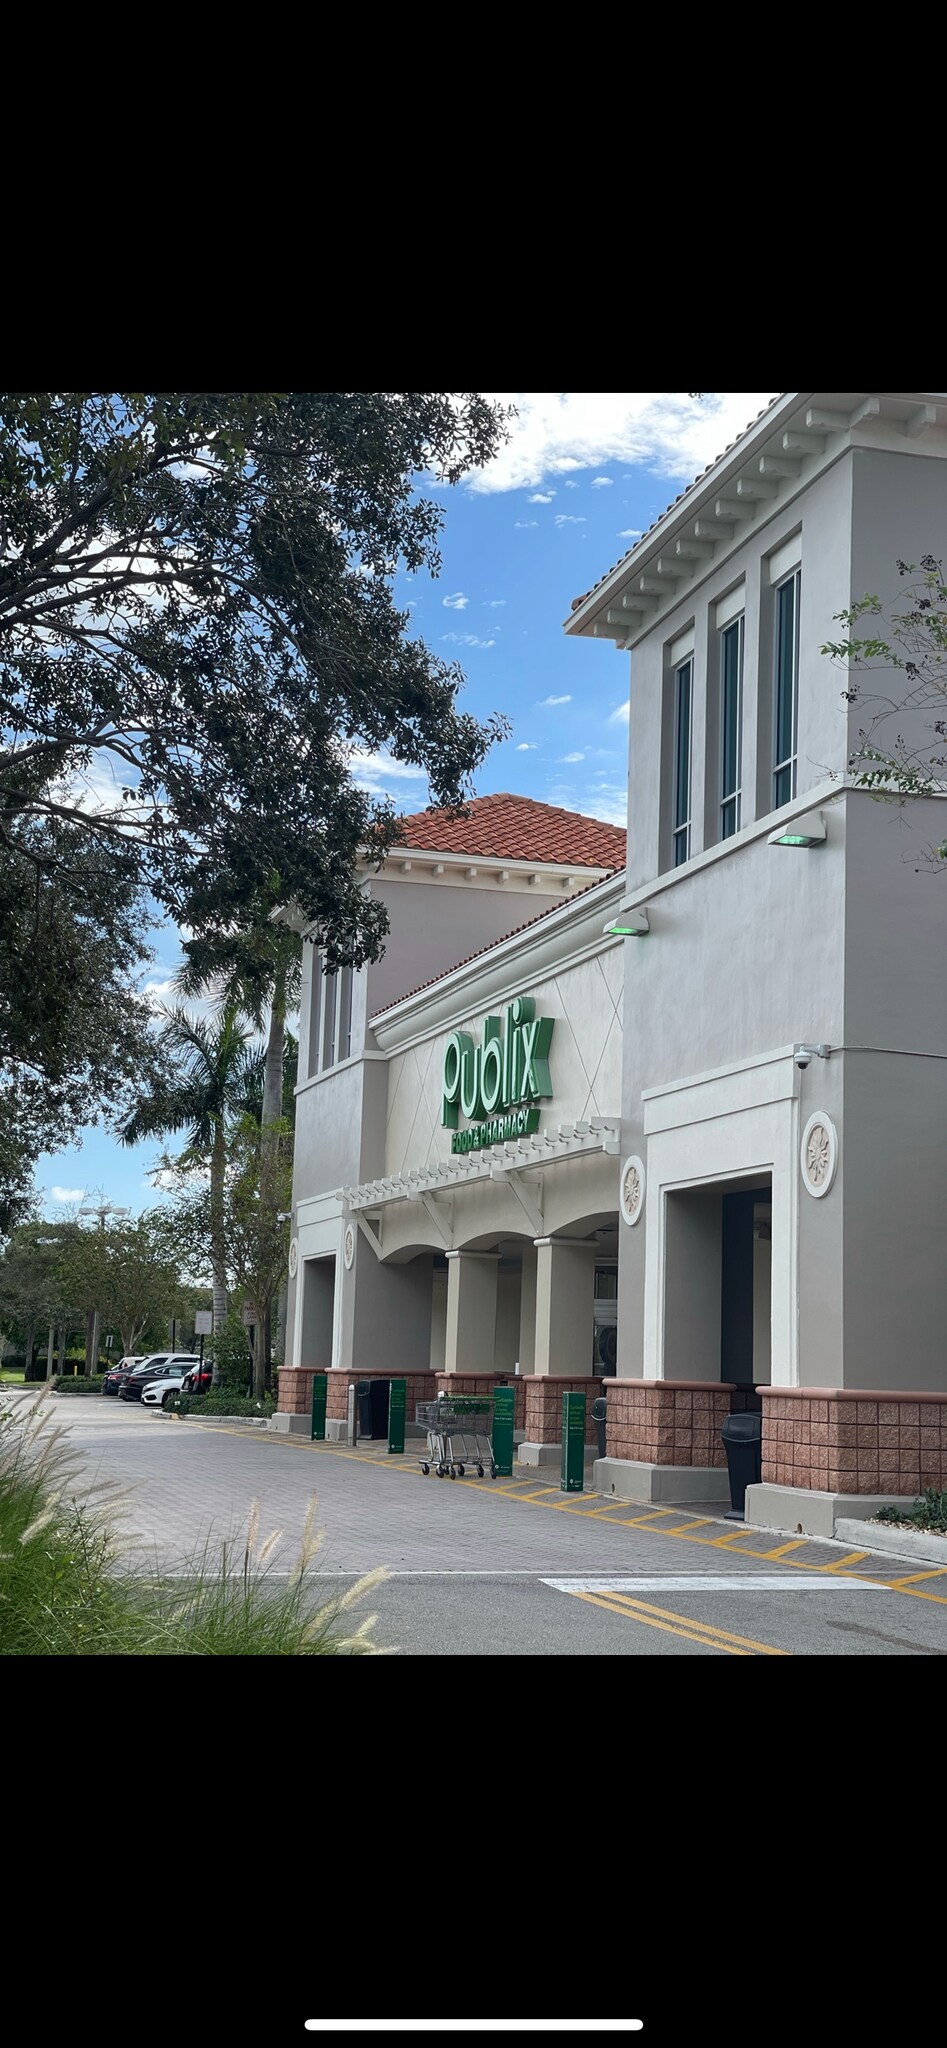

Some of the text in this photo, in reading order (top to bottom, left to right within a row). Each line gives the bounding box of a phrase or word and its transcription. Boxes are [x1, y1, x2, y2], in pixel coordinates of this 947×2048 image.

[441, 996, 550, 1129] Publix
[452, 1108, 532, 1154] FOOD & PHARMACY
